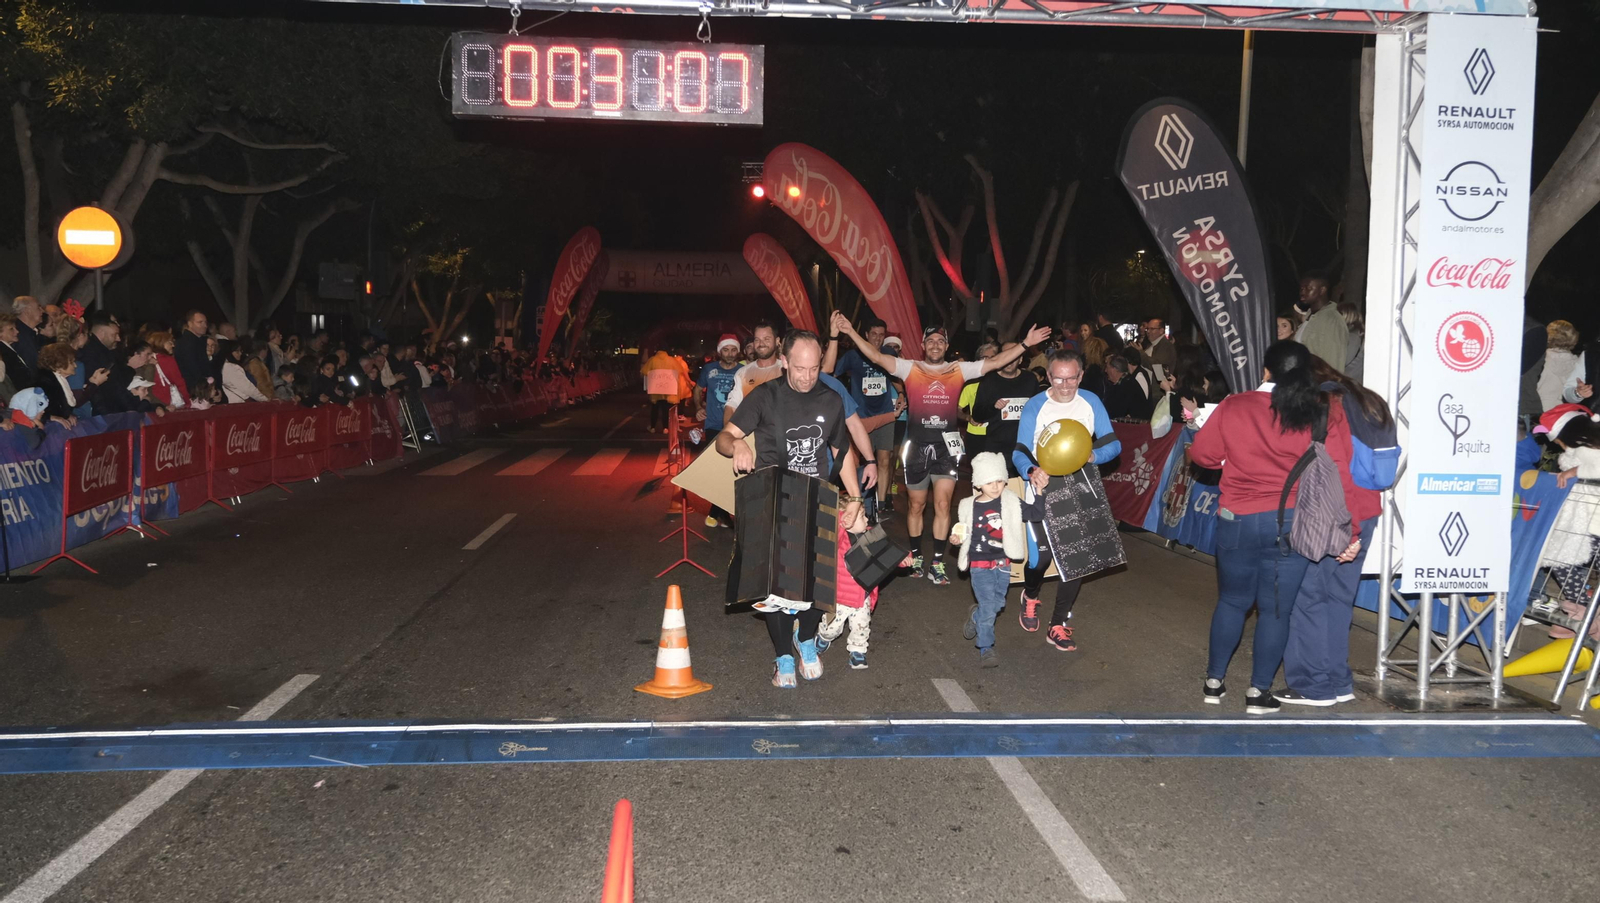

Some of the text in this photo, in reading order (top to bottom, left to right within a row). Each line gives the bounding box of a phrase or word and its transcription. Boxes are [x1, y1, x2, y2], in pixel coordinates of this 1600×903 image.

[1438, 105, 1516, 119] RENAULT
[1437, 119, 1514, 130] SYRSA AUTOMOCION
[1436, 185, 1508, 197] NISSAN
[1441, 224, 1504, 234] andalmotor.es
[653, 261, 732, 277] ALMERÍA
[1426, 256, 1518, 289] Coca-Cola
[652, 279, 693, 288] CIUDAD
[1420, 476, 1476, 492] Almericar
[0, 491, 35, 526] RÍA
[1414, 568, 1490, 578] RENAULT
[1414, 581, 1489, 590] SYRSA AUTOMOCION
